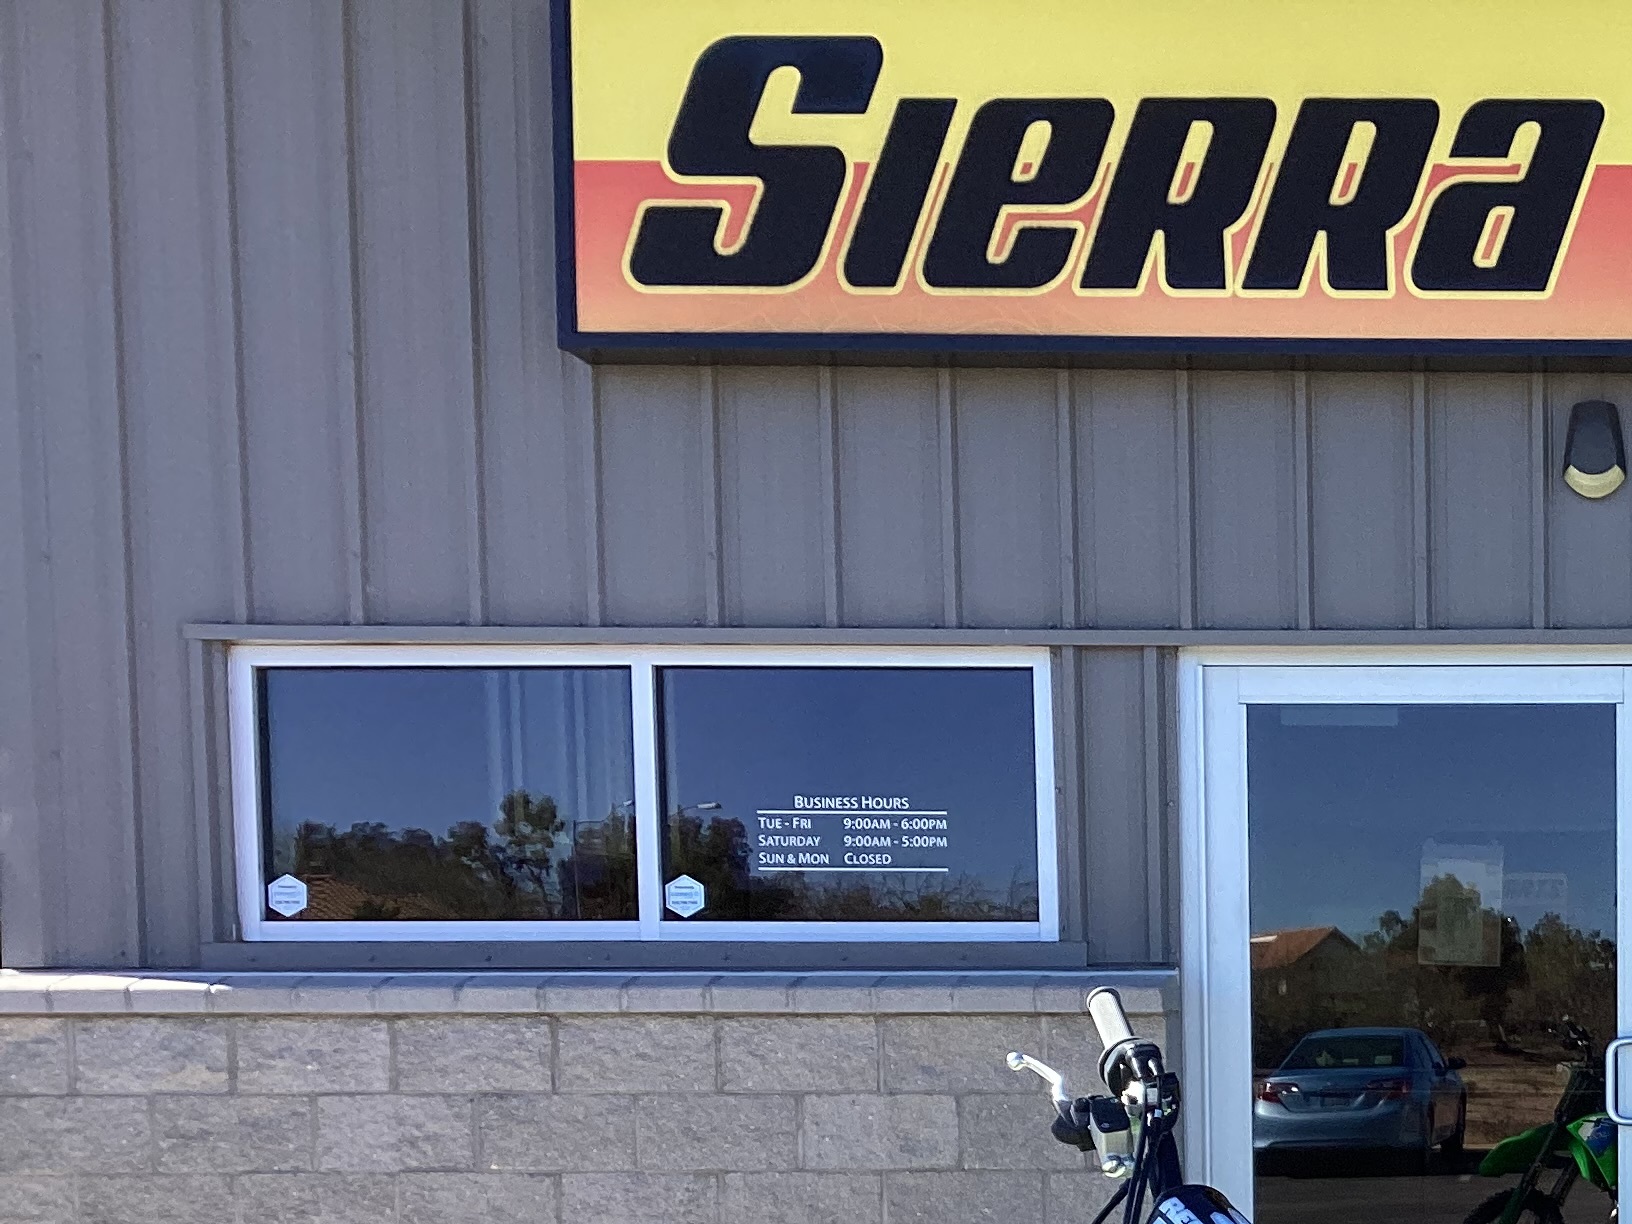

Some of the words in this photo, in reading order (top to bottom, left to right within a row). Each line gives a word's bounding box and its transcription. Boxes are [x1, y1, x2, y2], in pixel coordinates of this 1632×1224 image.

[843, 818, 891, 830] 9:00AM
[901, 818, 948, 830] 6:00PM
[843, 835, 892, 847] 9:00AM
[901, 835, 948, 848] 5:00PM
[786, 853, 796, 864] &
